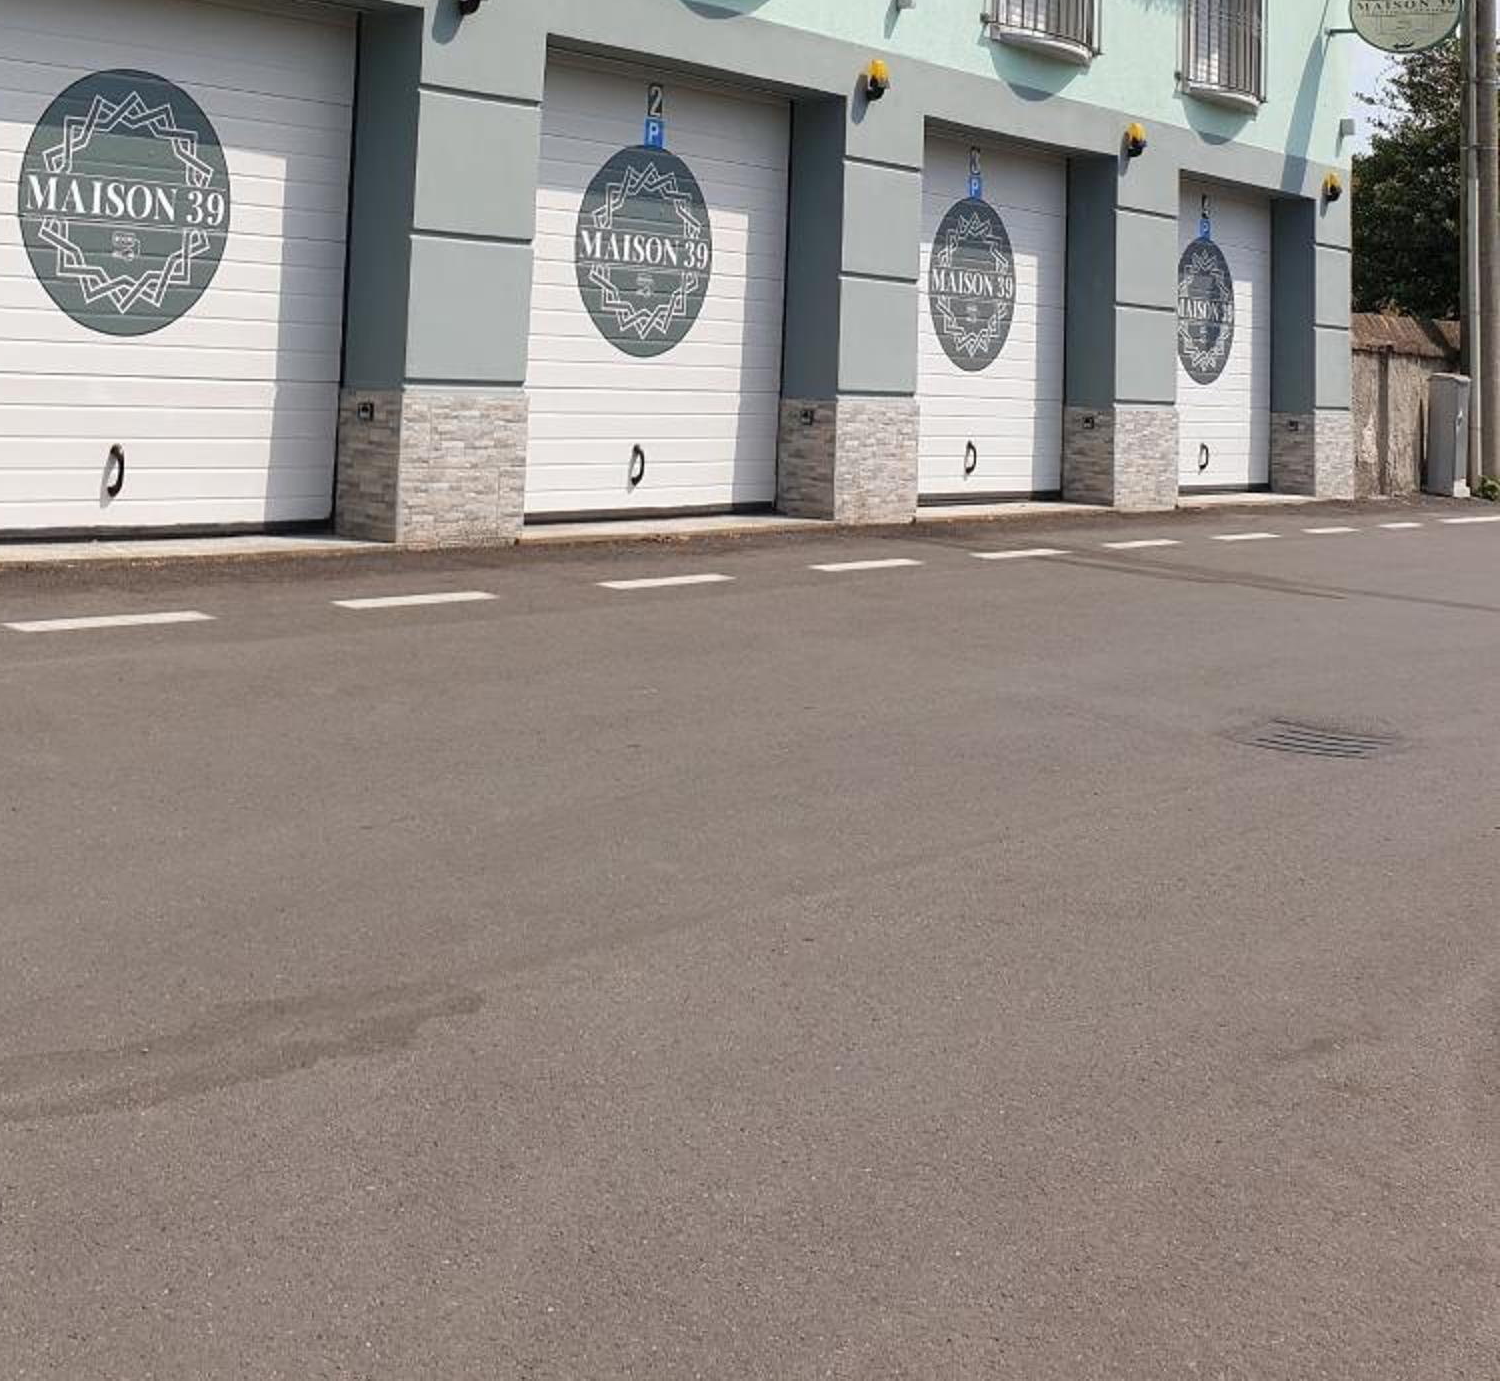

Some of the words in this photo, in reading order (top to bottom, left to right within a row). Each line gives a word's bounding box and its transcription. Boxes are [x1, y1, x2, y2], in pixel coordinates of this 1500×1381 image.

[1357, 0, 1429, 12] MAISON
[649, 85, 662, 116] 2
[649, 122, 659, 144] P
[26, 174, 178, 221] MAISON
[186, 190, 226, 227] 39
[579, 229, 680, 267] MAISON
[683, 239, 709, 270] 39
[931, 268, 994, 297] MAISON
[996, 276, 1013, 299] 39
[1178, 299, 1220, 321] MAISON
